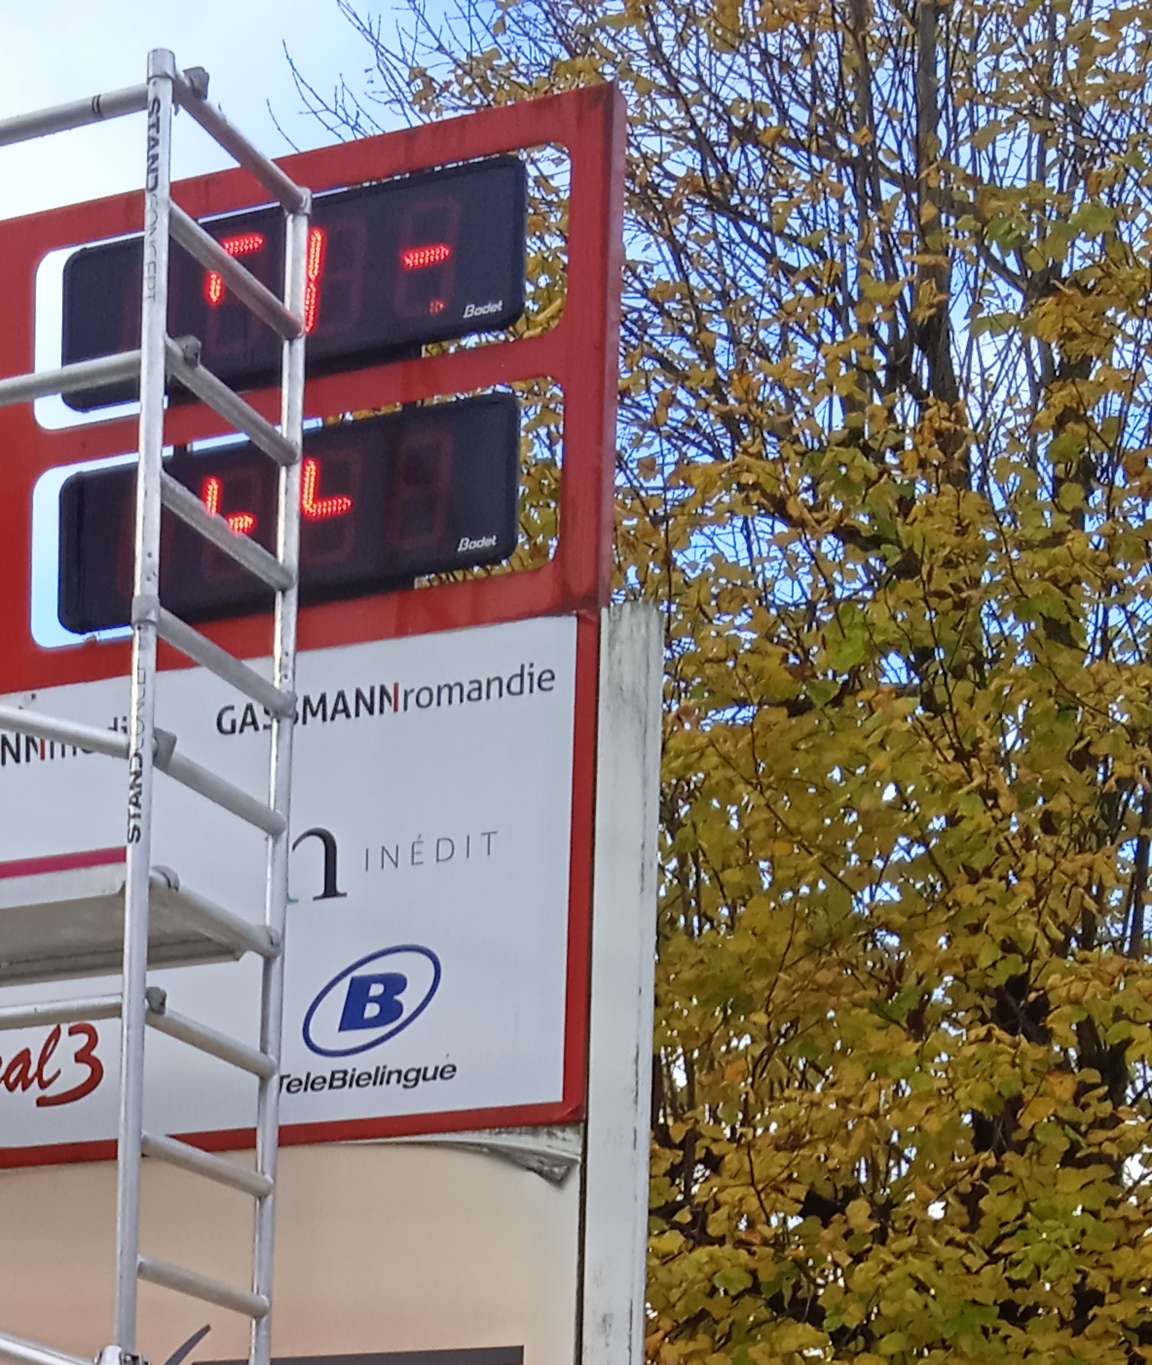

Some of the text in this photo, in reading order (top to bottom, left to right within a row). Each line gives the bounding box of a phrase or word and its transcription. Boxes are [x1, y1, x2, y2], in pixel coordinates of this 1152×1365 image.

[463, 300, 503, 319] Bodet
[457, 535, 497, 552] Bodet
[364, 831, 499, 873] INÉDIT
[337, 971, 408, 1034] B
